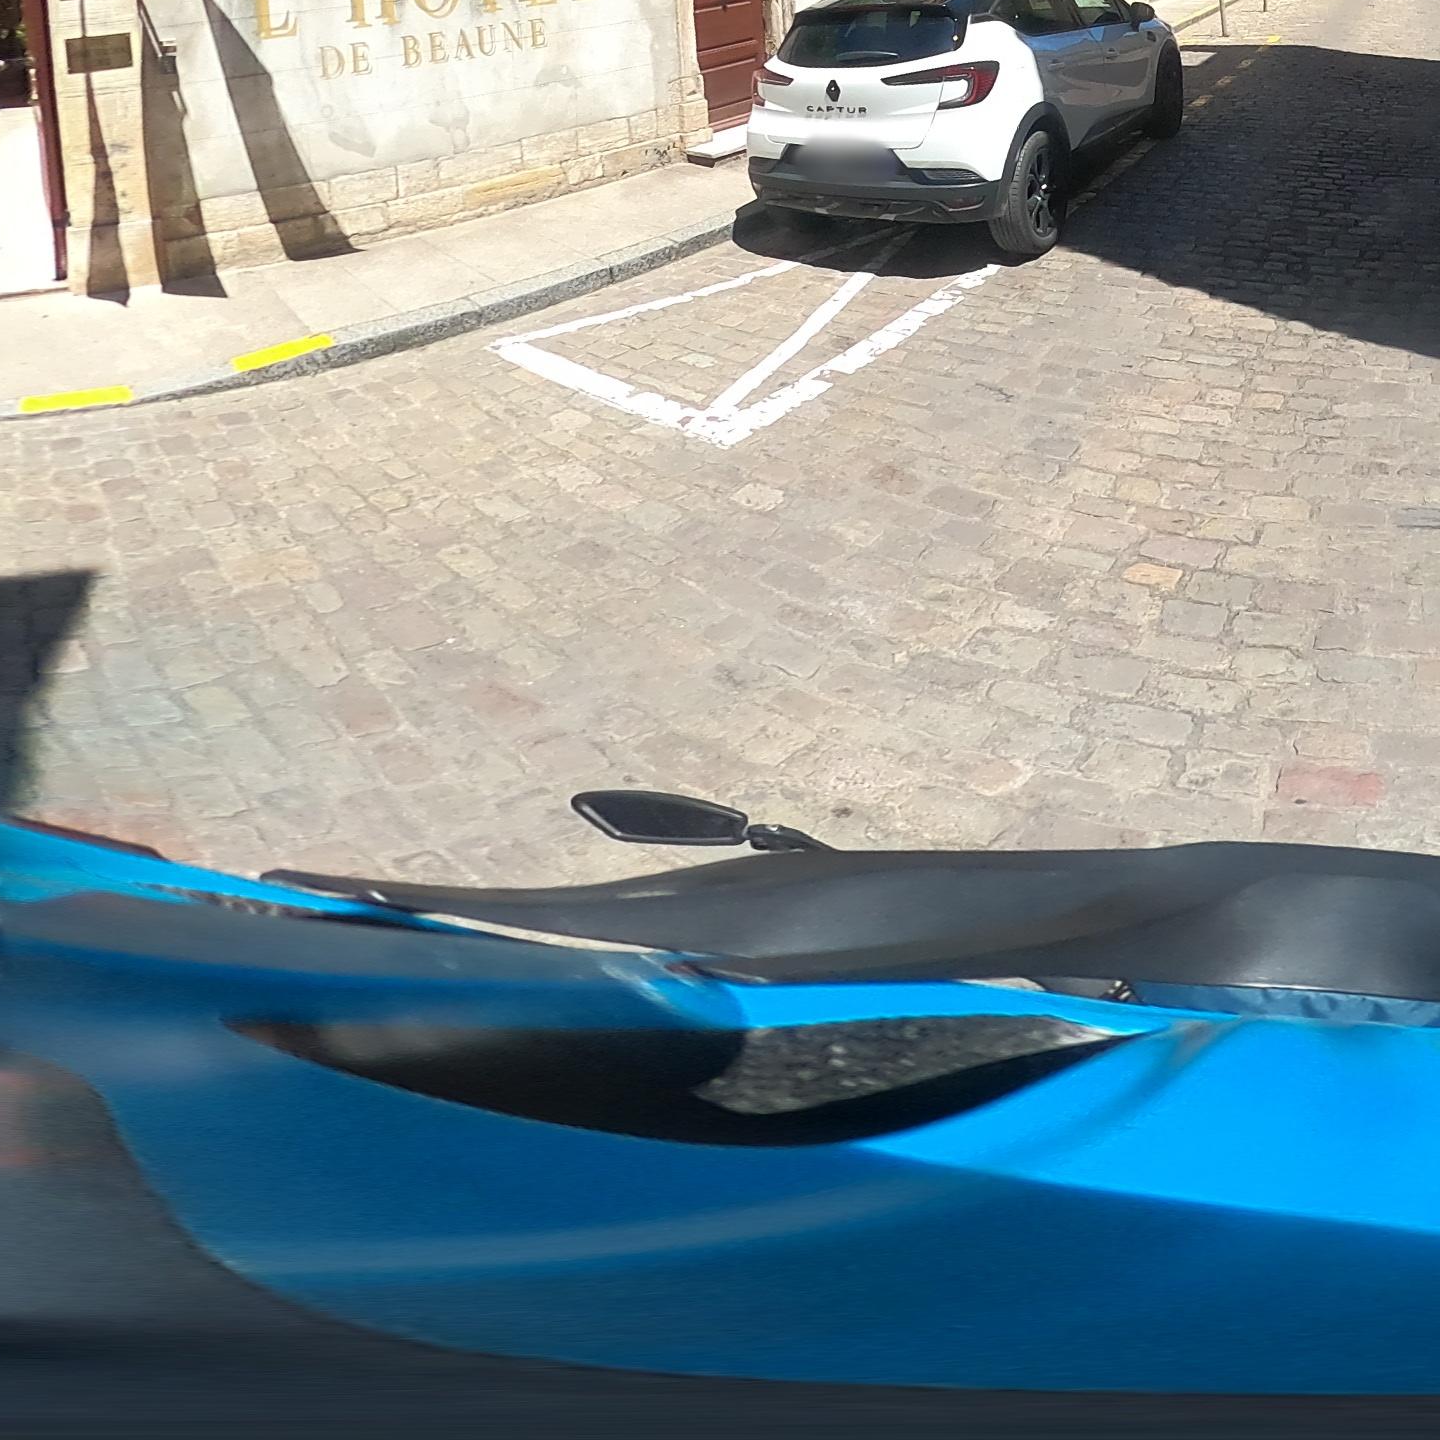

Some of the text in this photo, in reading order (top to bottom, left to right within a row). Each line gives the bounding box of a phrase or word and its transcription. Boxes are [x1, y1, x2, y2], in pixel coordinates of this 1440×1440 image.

[319, 18, 549, 80] DE BEAUNE
[806, 105, 867, 114] CAPTUR
